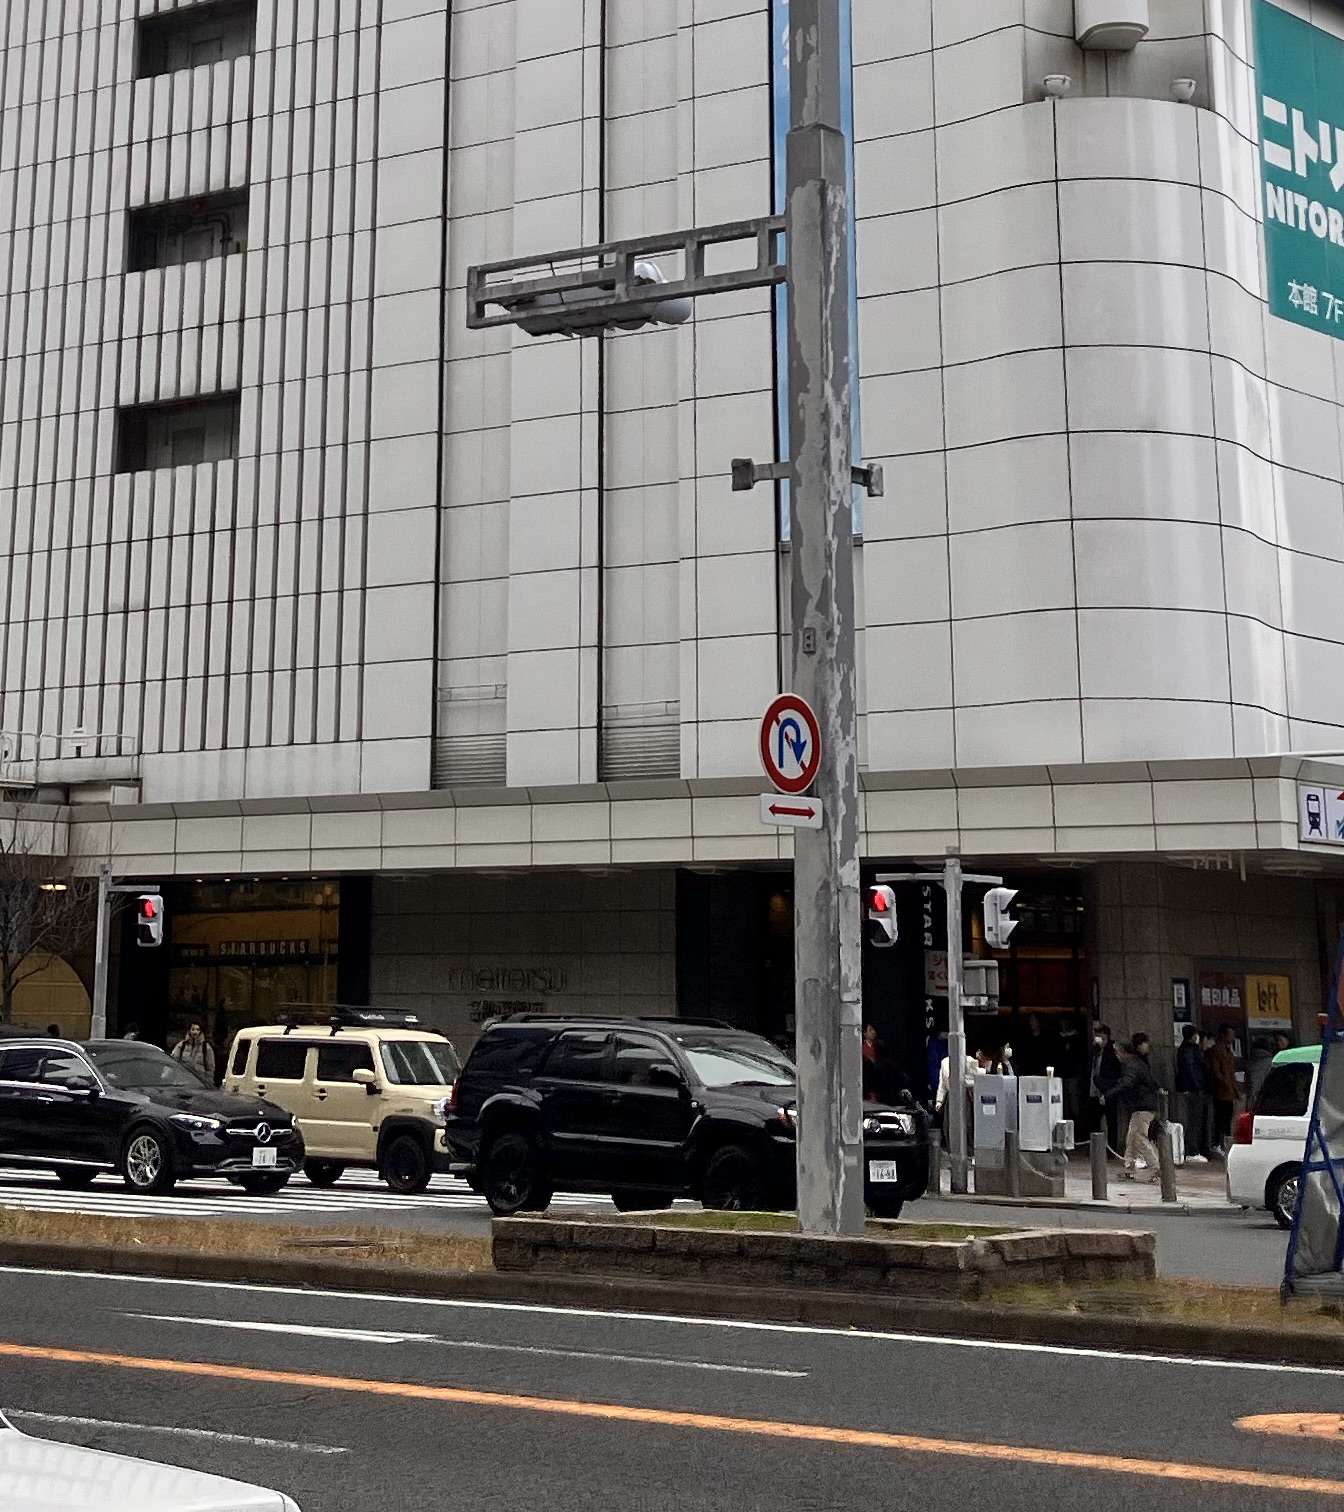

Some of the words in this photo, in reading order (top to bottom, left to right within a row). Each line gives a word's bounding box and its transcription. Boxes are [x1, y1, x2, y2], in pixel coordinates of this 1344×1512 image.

[1287, 277, 1318, 315] 本館
[1320, 287, 1344, 324] 7F
[220, 941, 306, 956] STARBUCKS
